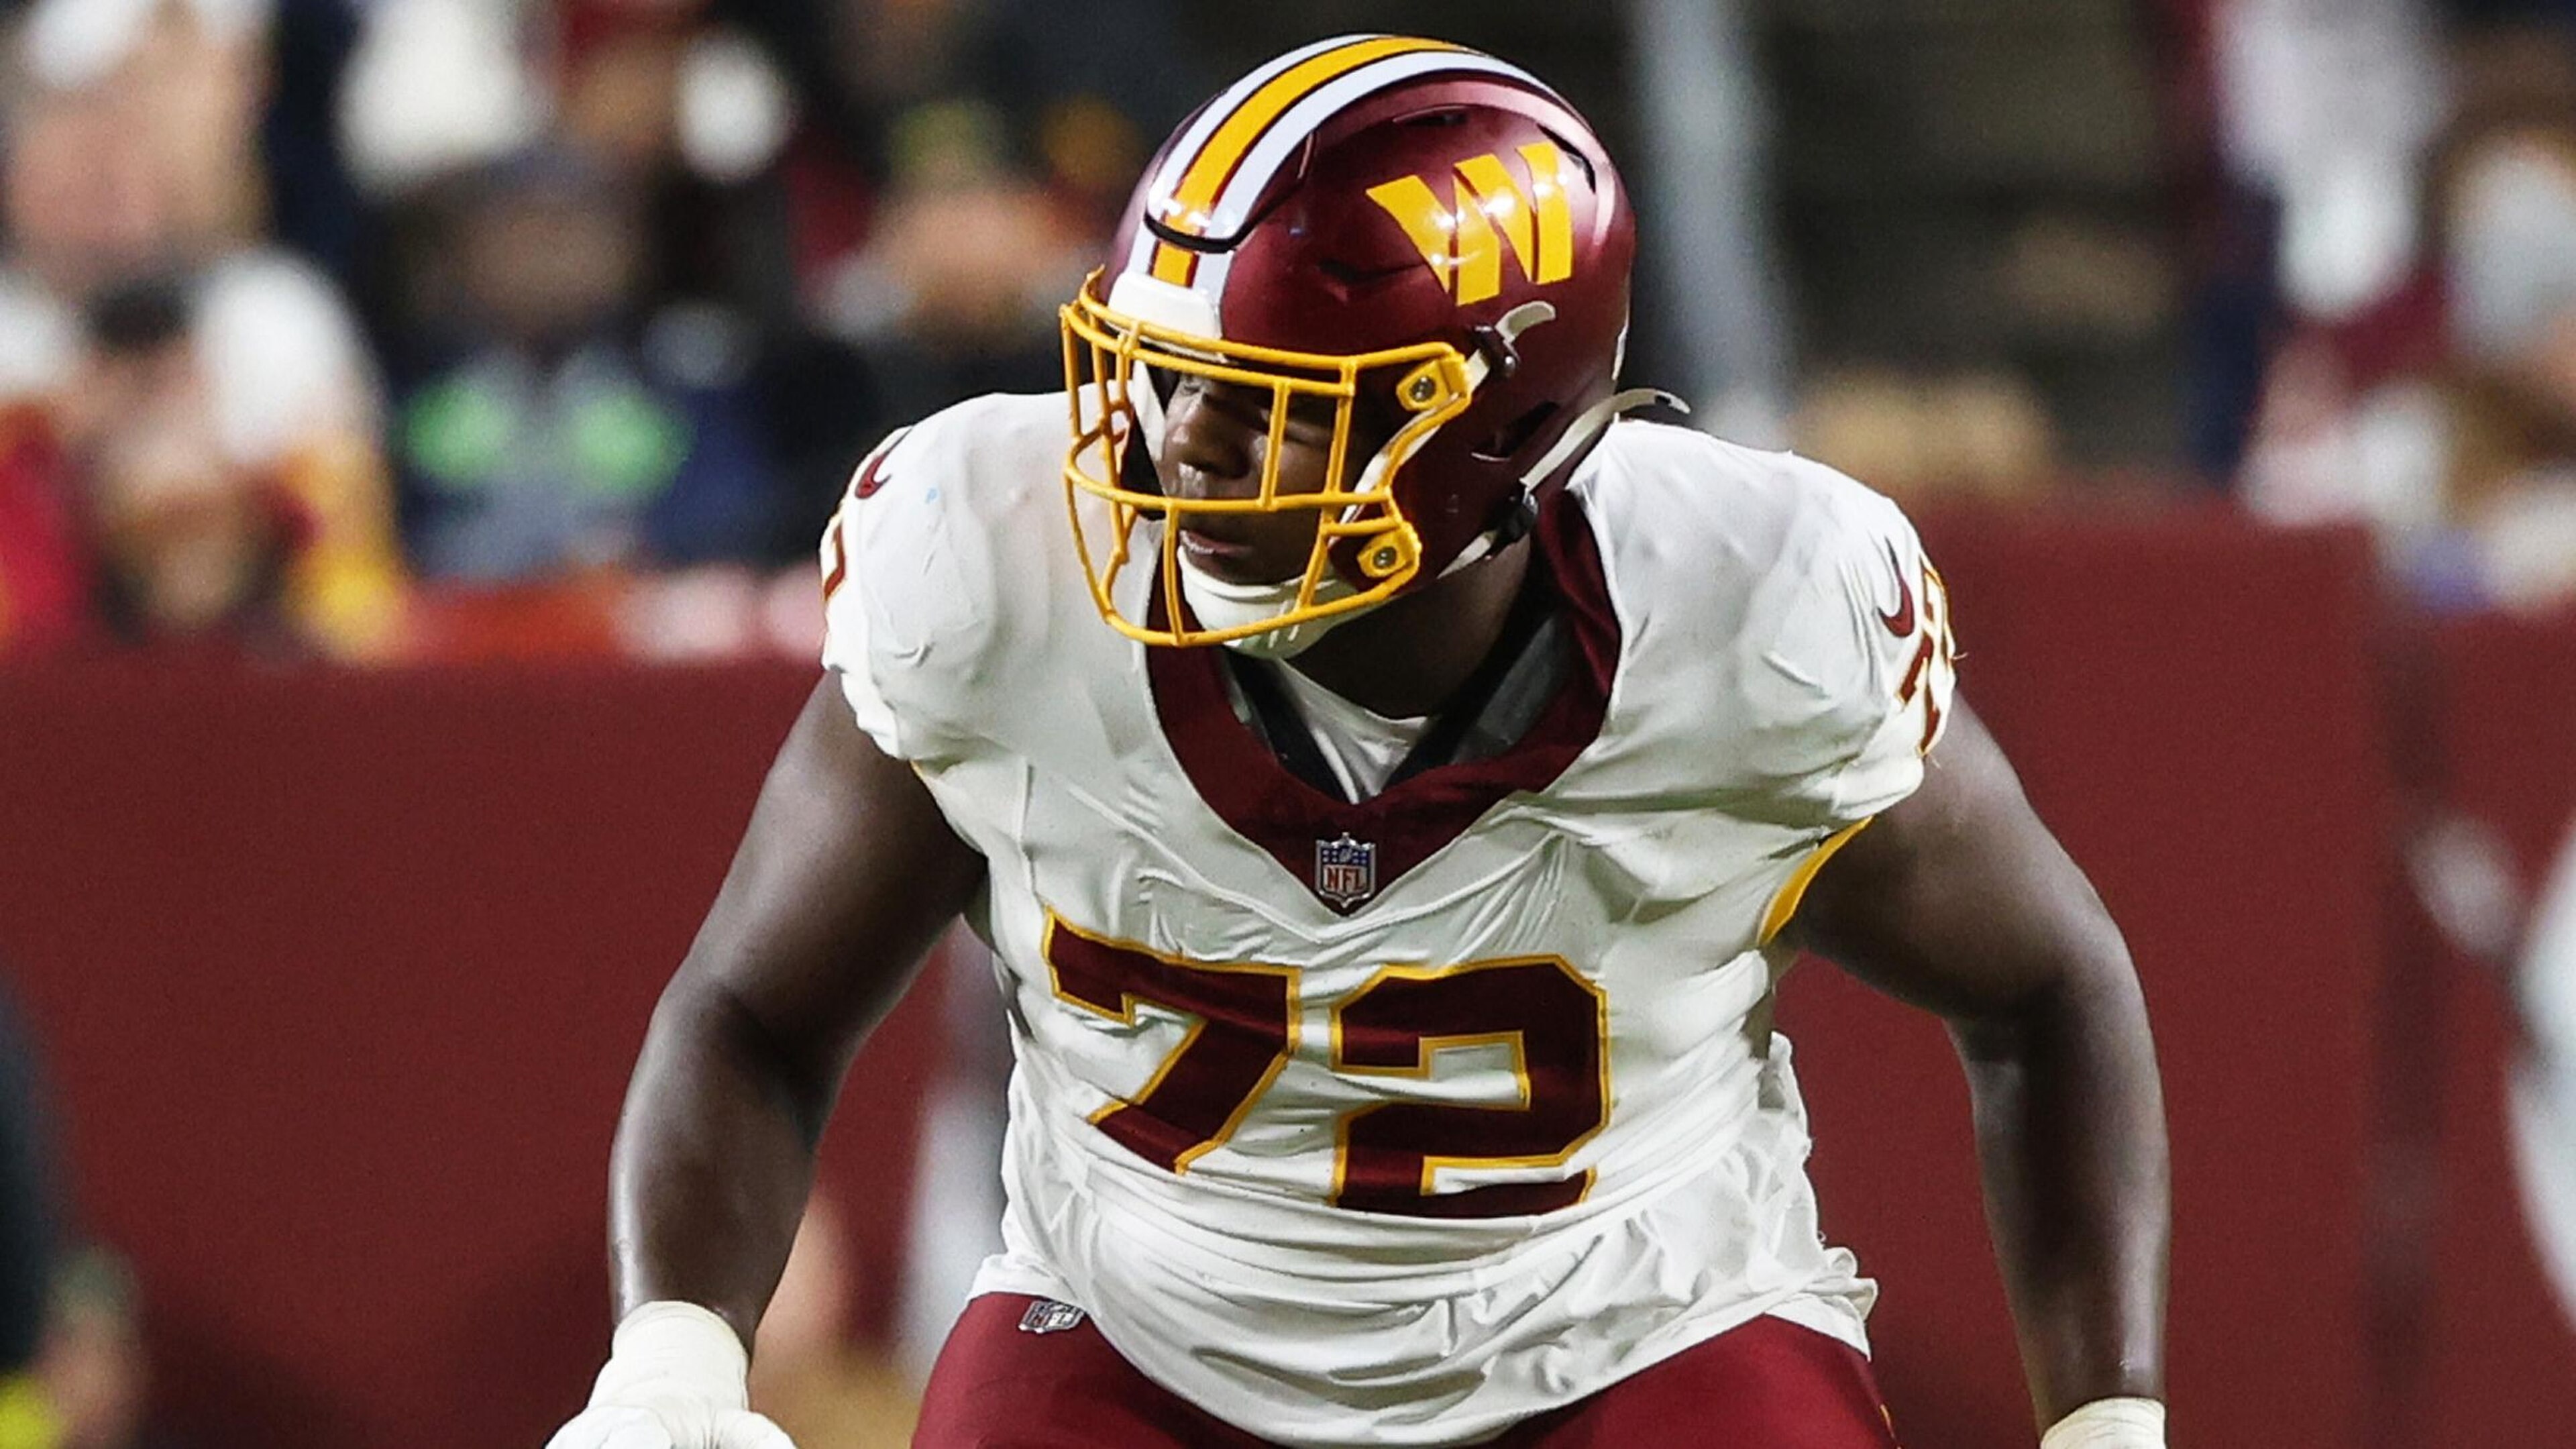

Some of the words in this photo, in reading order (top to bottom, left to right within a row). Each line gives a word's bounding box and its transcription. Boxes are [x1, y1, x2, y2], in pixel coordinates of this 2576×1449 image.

[1365, 141, 1573, 307] W
[1324, 866, 1366, 894] NFL
[1040, 906, 1609, 1220] 72
